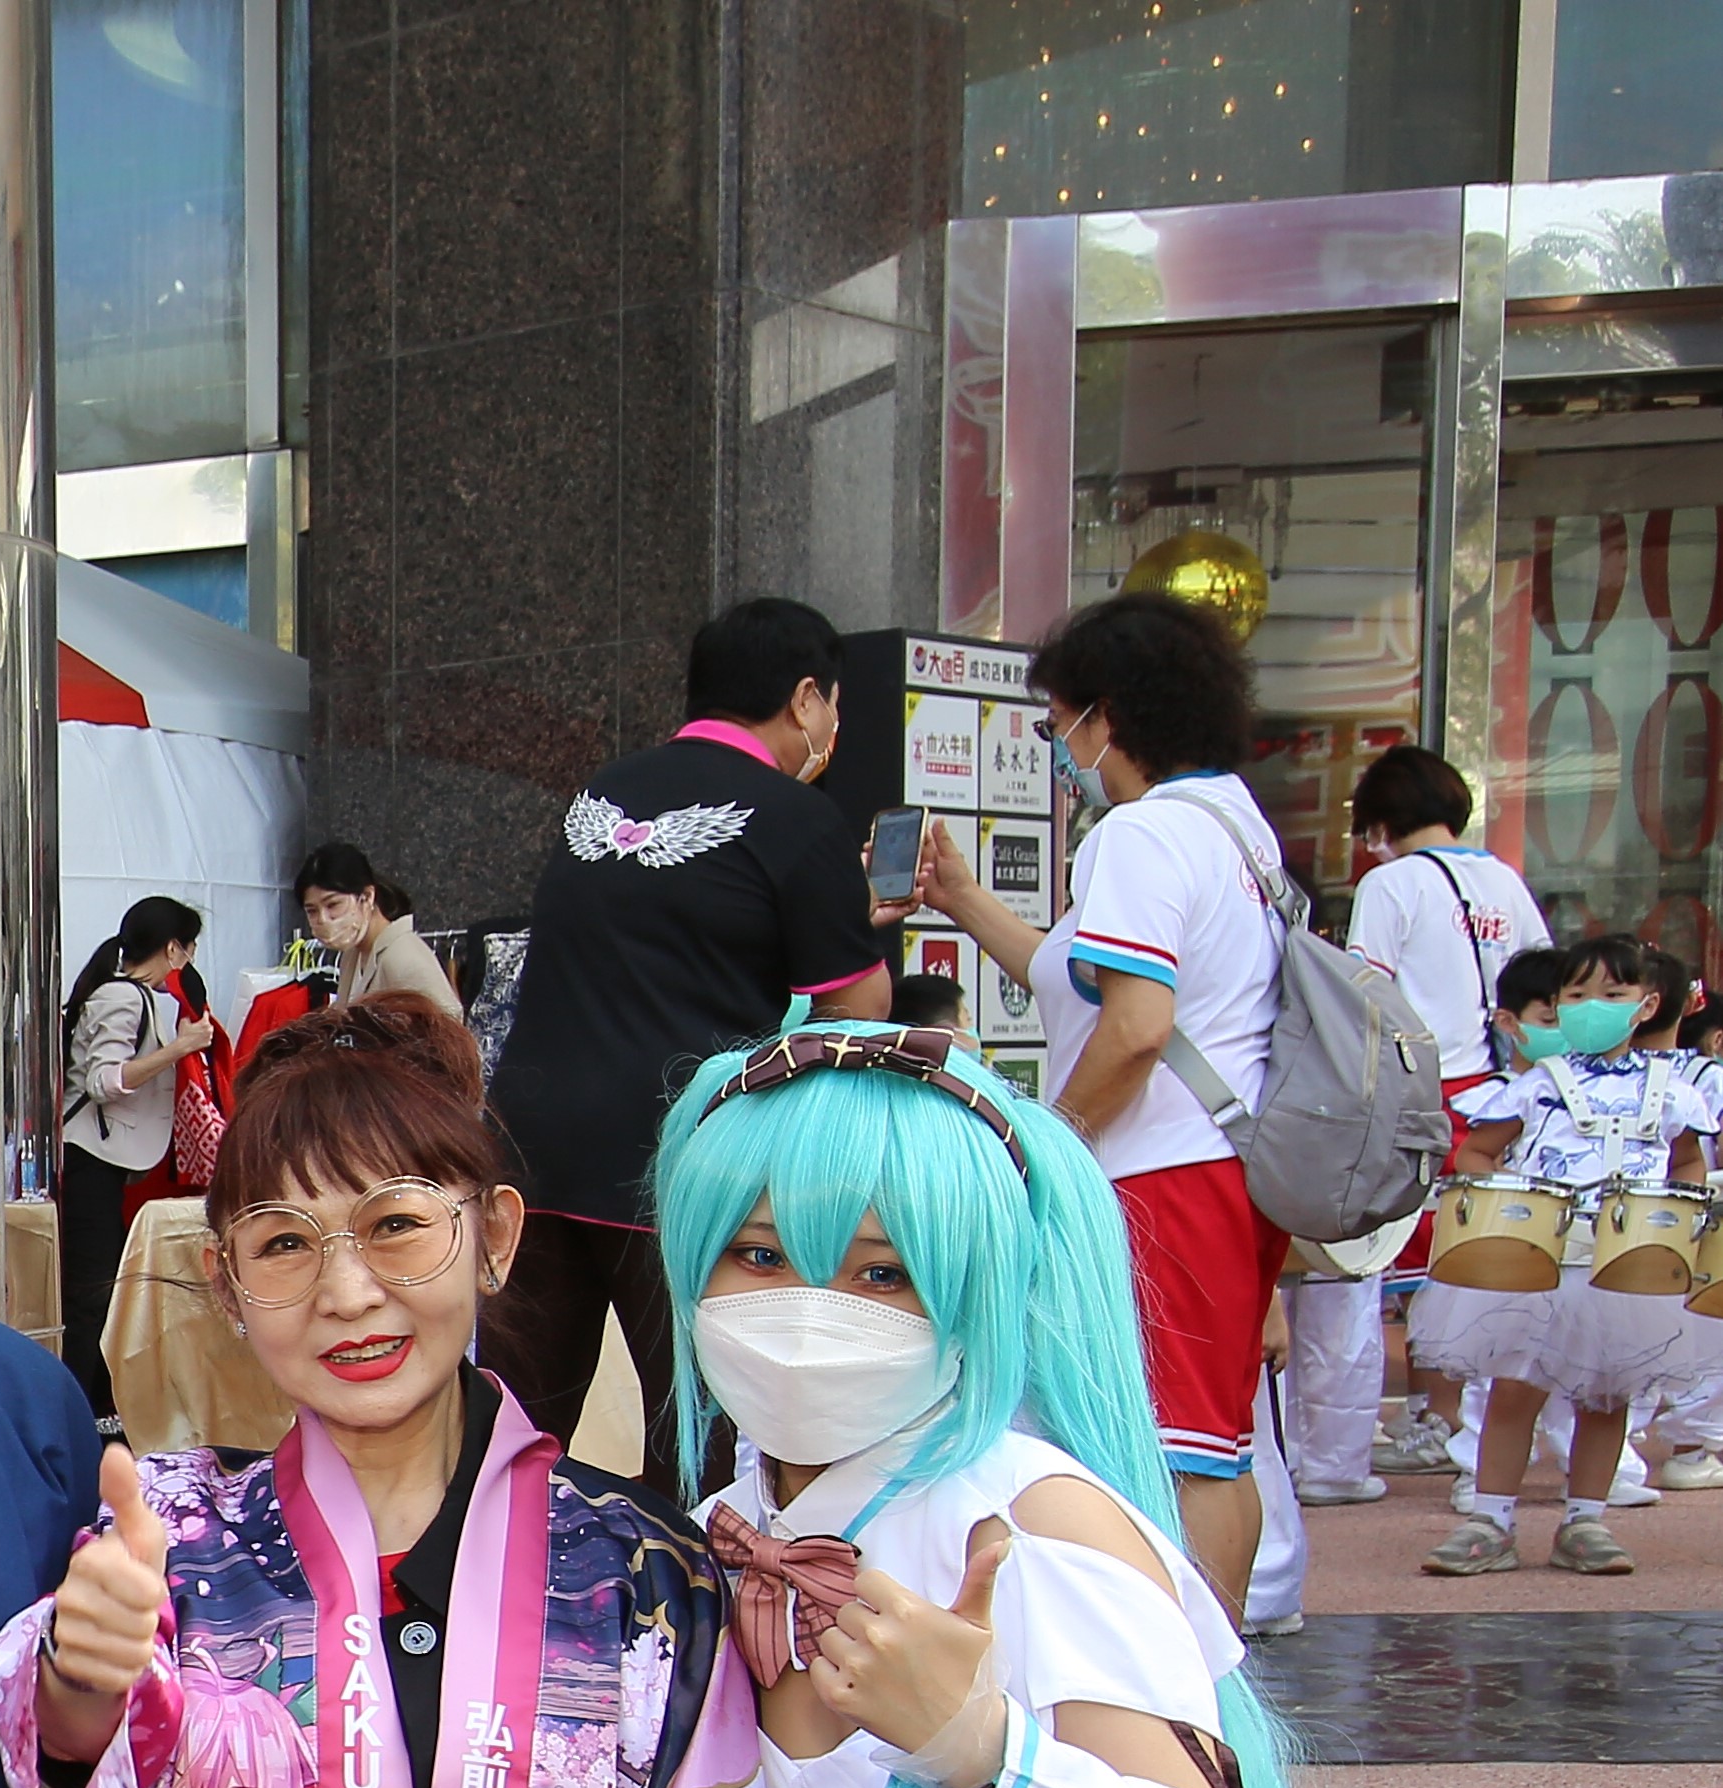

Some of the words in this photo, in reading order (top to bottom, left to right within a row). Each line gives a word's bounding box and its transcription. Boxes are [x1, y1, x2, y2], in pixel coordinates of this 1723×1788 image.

[970, 659, 1028, 684] 成功店餐飲
